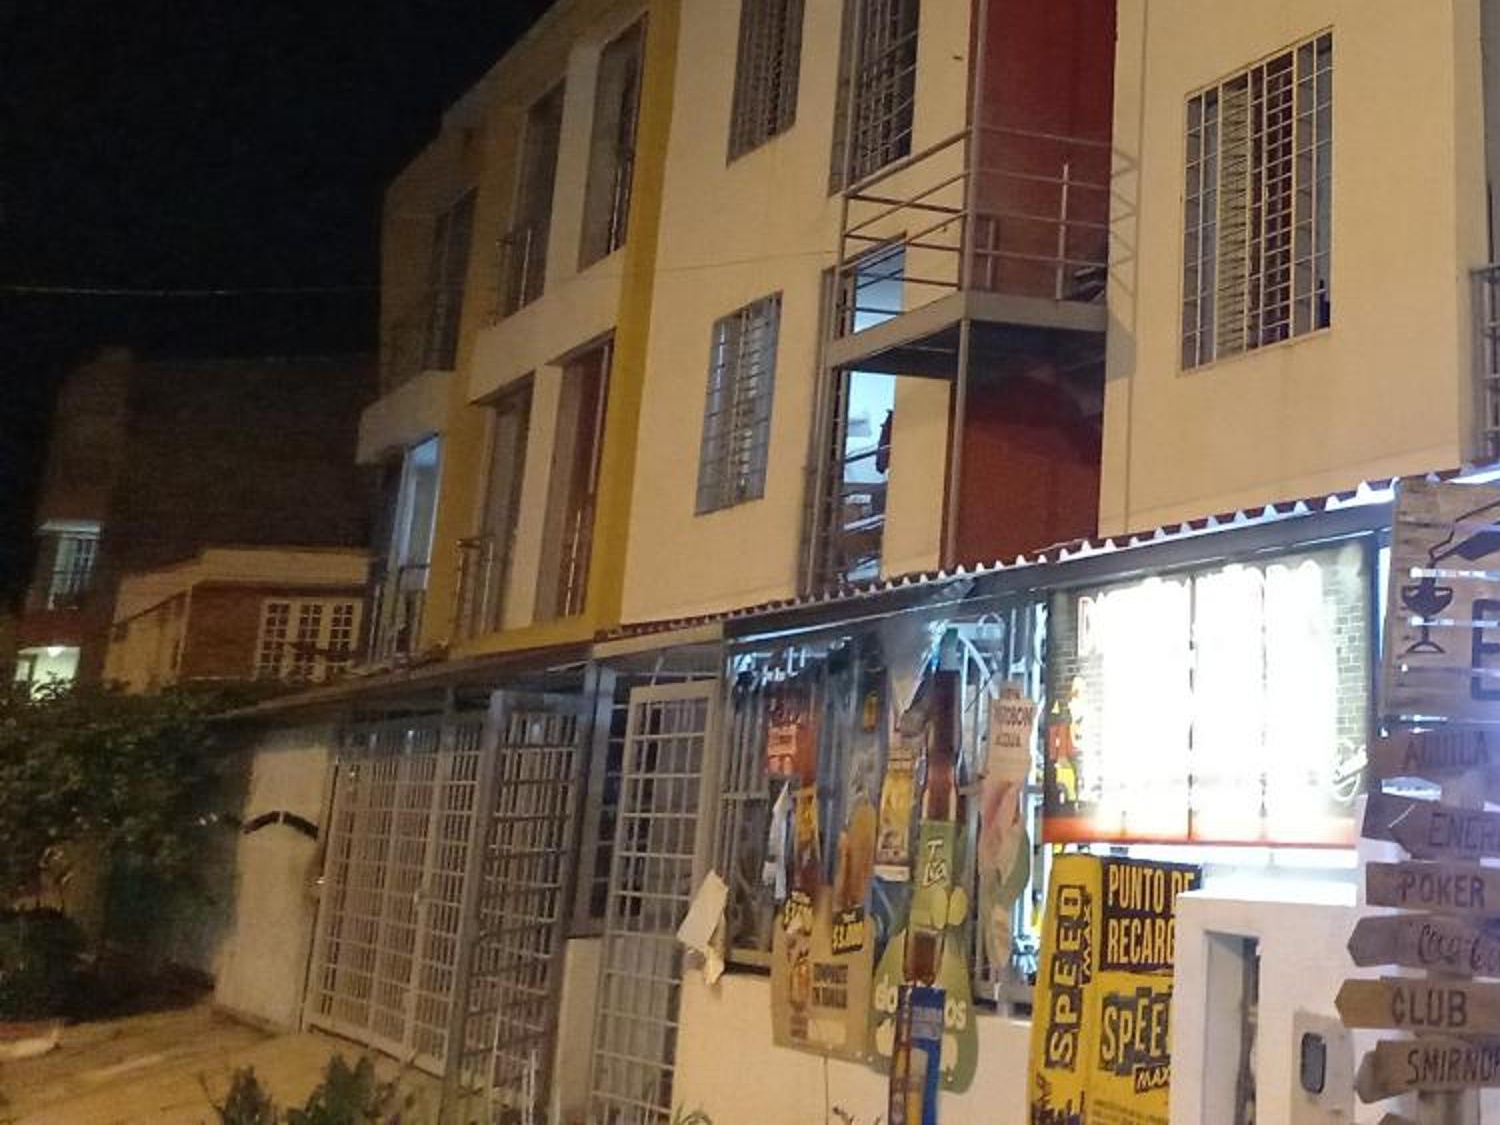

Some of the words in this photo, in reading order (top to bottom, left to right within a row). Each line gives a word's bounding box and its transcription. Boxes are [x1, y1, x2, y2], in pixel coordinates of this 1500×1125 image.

[1108, 864, 1165, 913] PUNTO
[1401, 874, 1486, 908] POKER
[1107, 918, 1176, 965] RECARG
[1050, 888, 1082, 1064] SPEED
[1101, 998, 1166, 1063] SPEE
[1391, 986, 1468, 1028] CLUB
